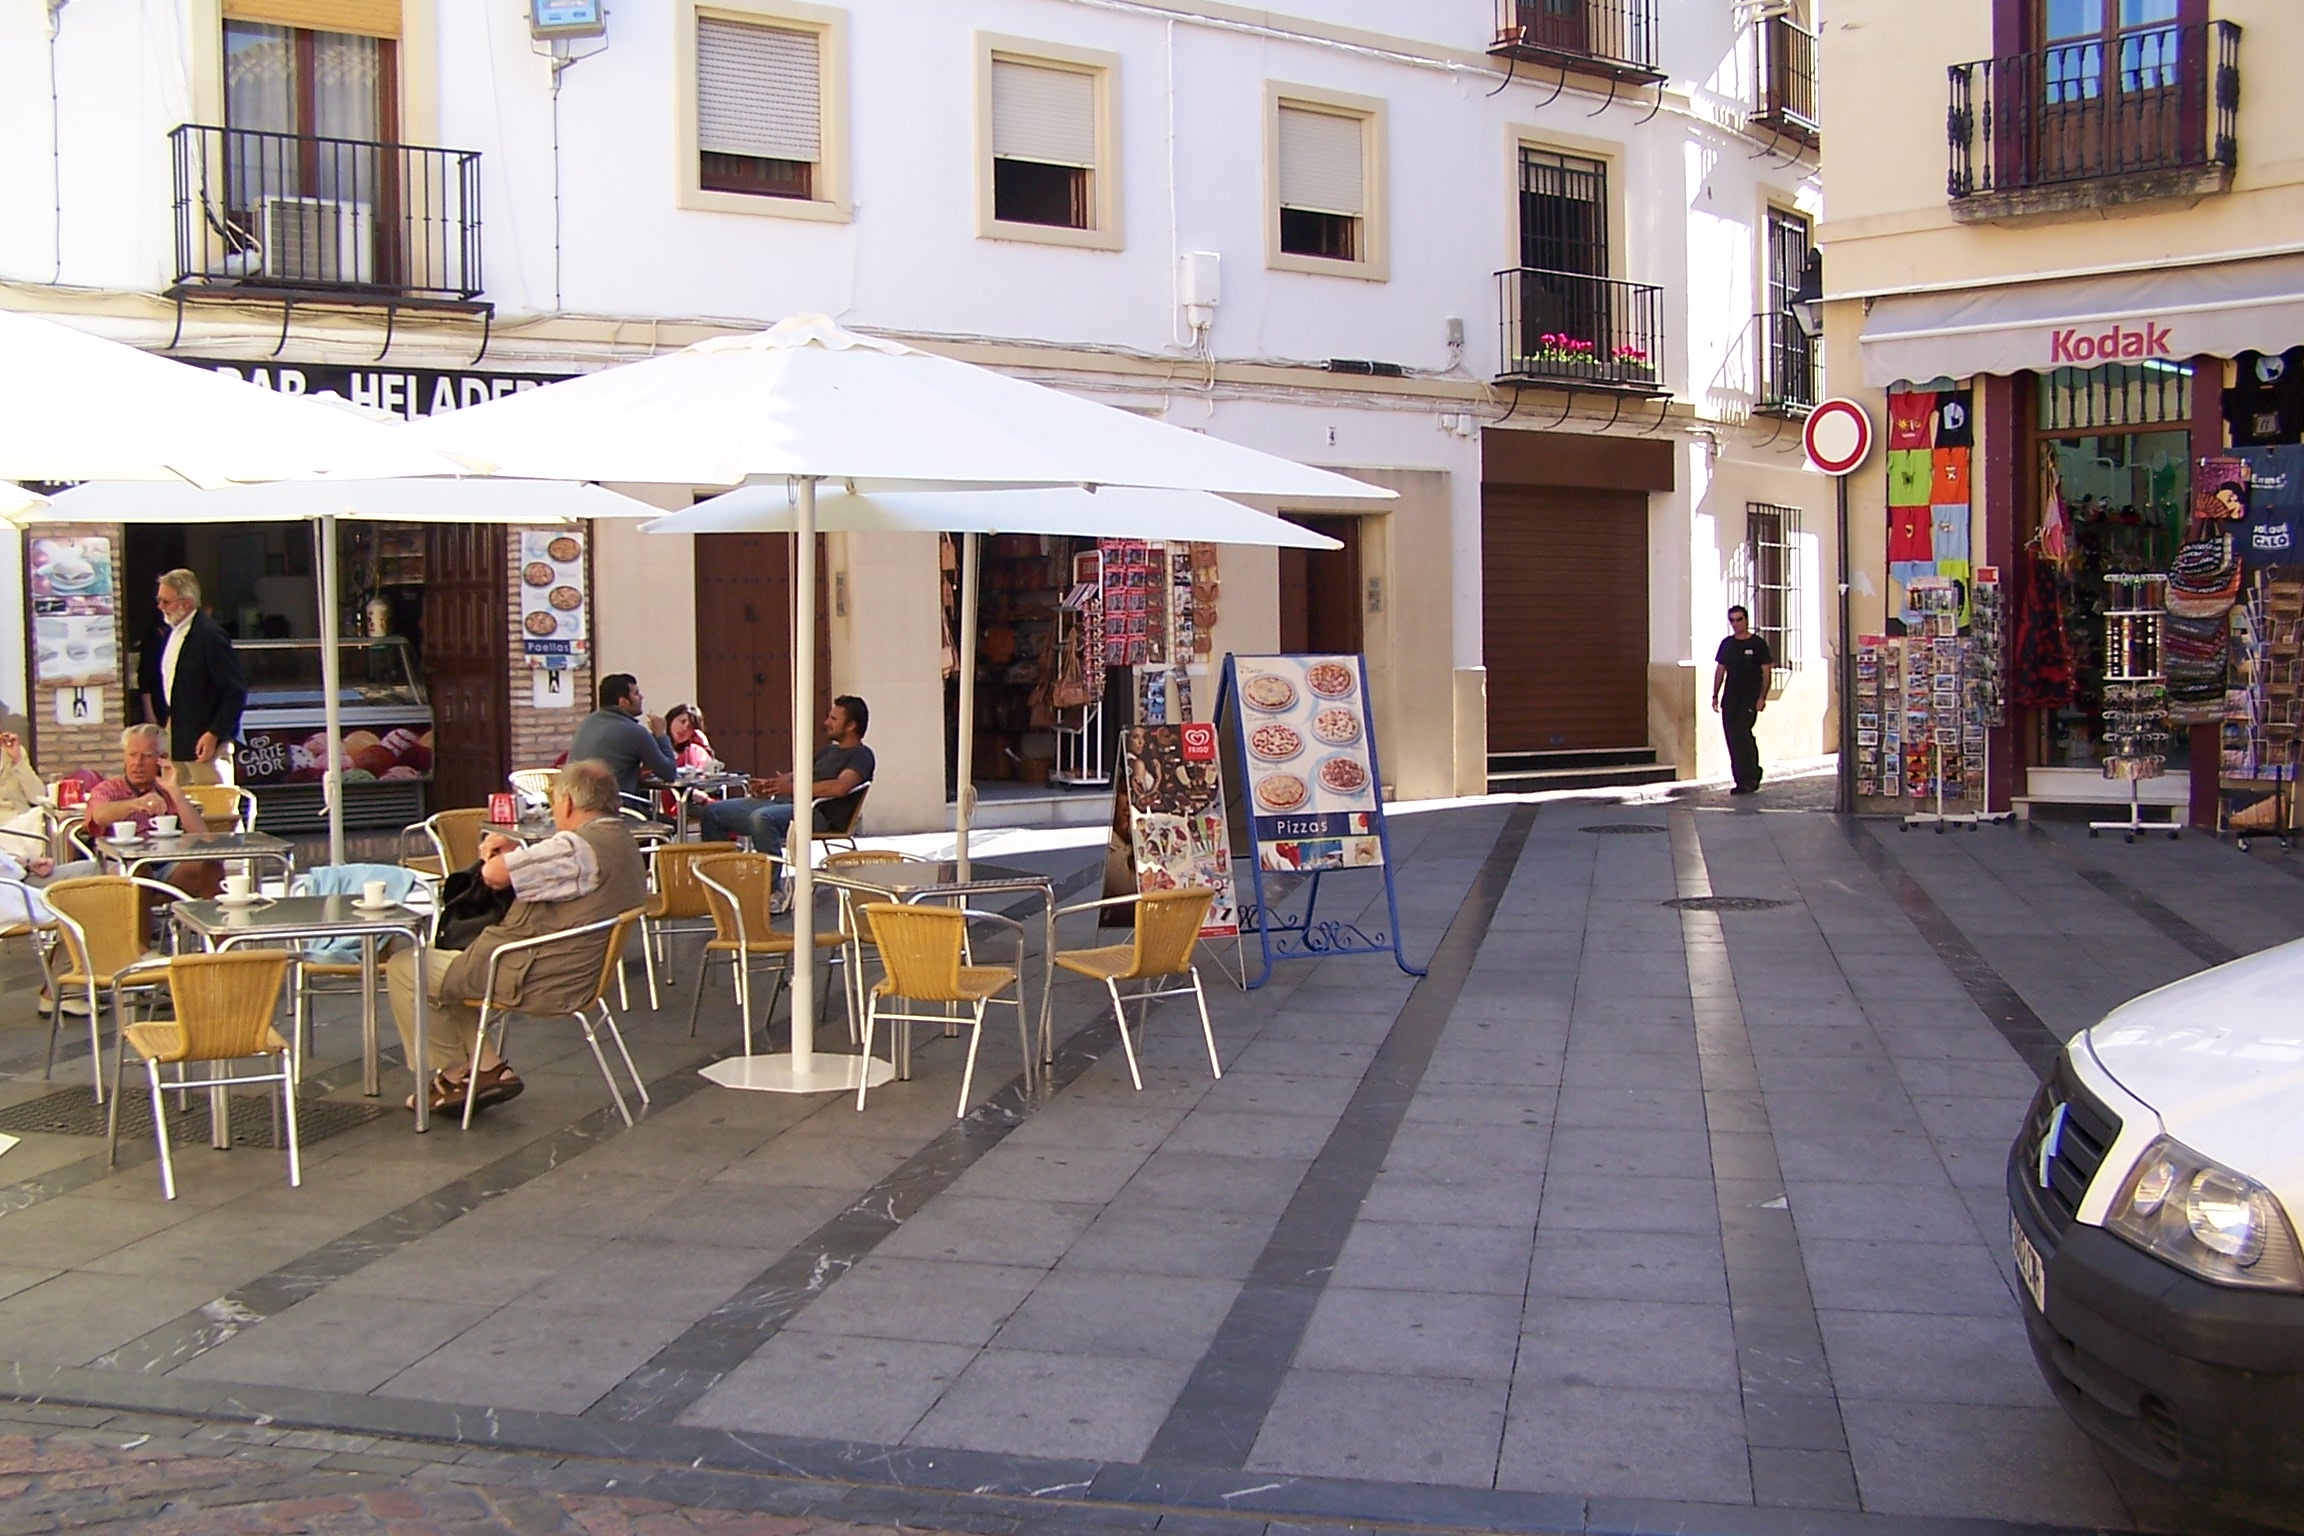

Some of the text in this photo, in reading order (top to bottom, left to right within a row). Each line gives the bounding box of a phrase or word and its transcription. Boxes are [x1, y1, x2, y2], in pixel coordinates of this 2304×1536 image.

[2050, 321, 2173, 363] Kodak
[527, 641, 569, 653] Paellas
[239, 742, 286, 765] CARTE
[1188, 745, 1210, 754] FRIGO
[1276, 820, 1329, 835] Pizzas
